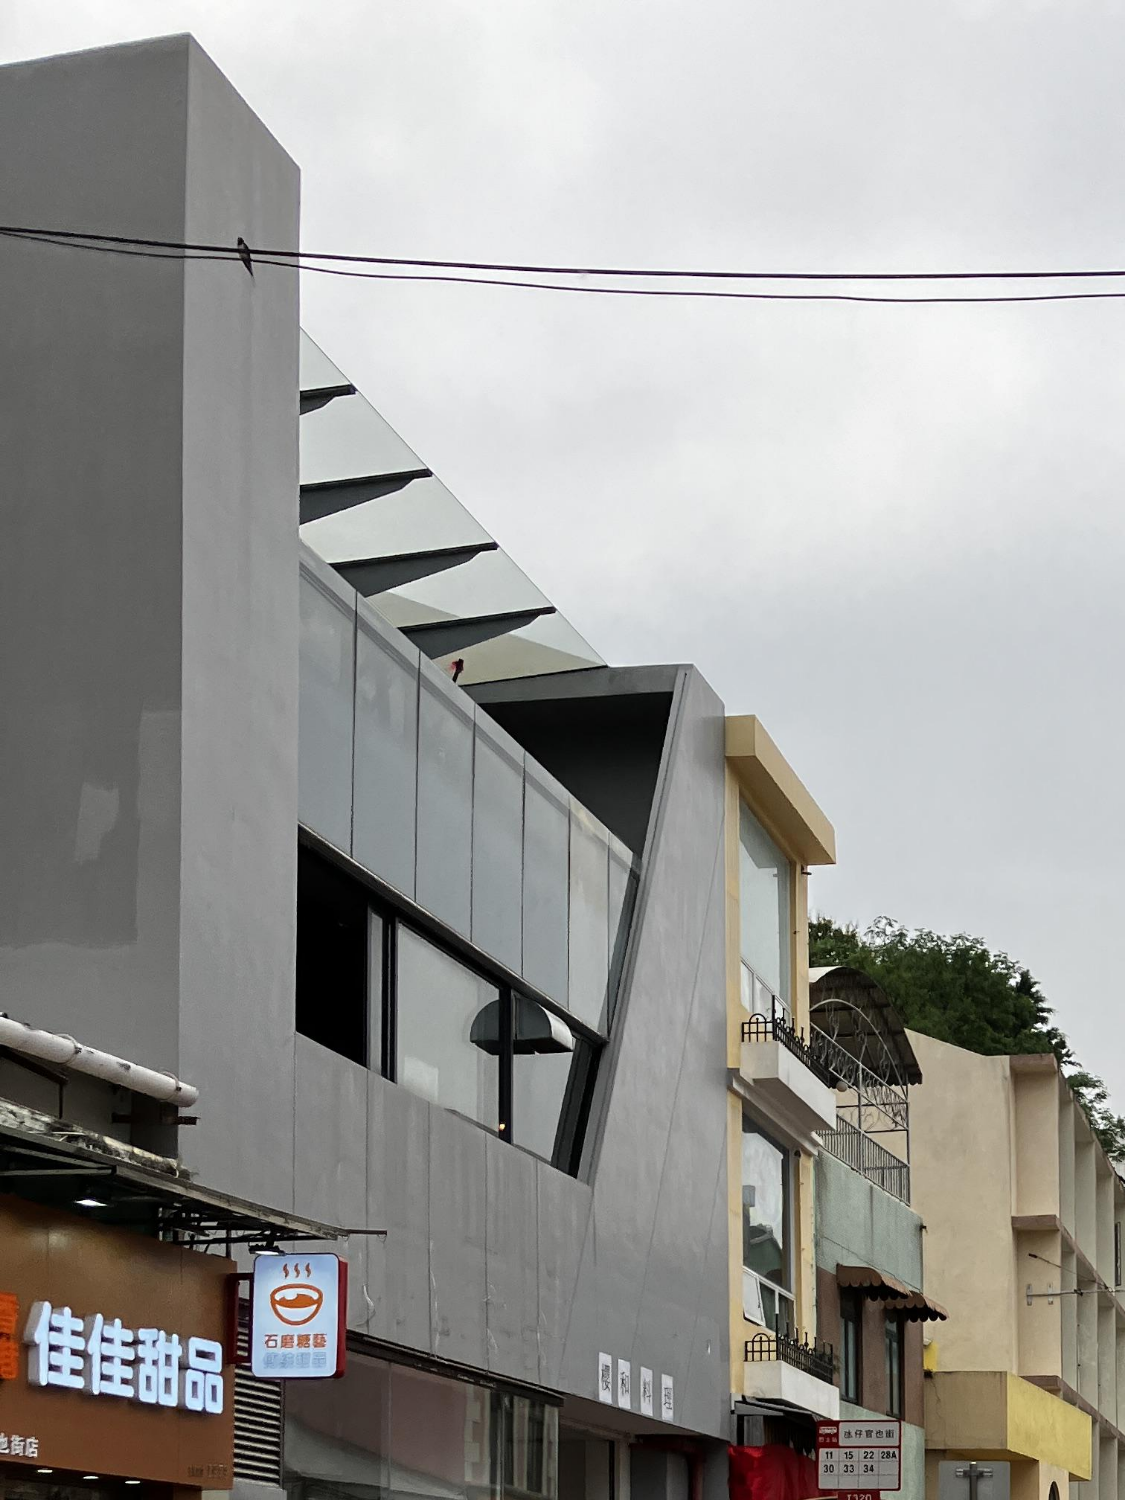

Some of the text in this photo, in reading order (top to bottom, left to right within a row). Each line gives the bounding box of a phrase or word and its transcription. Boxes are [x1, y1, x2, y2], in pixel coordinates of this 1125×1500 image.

[32, 1300, 224, 1415] 佳佳甜品
[825, 1450, 897, 1460] 11 15 22 28A
[823, 1464, 875, 1473] 30 33 34
